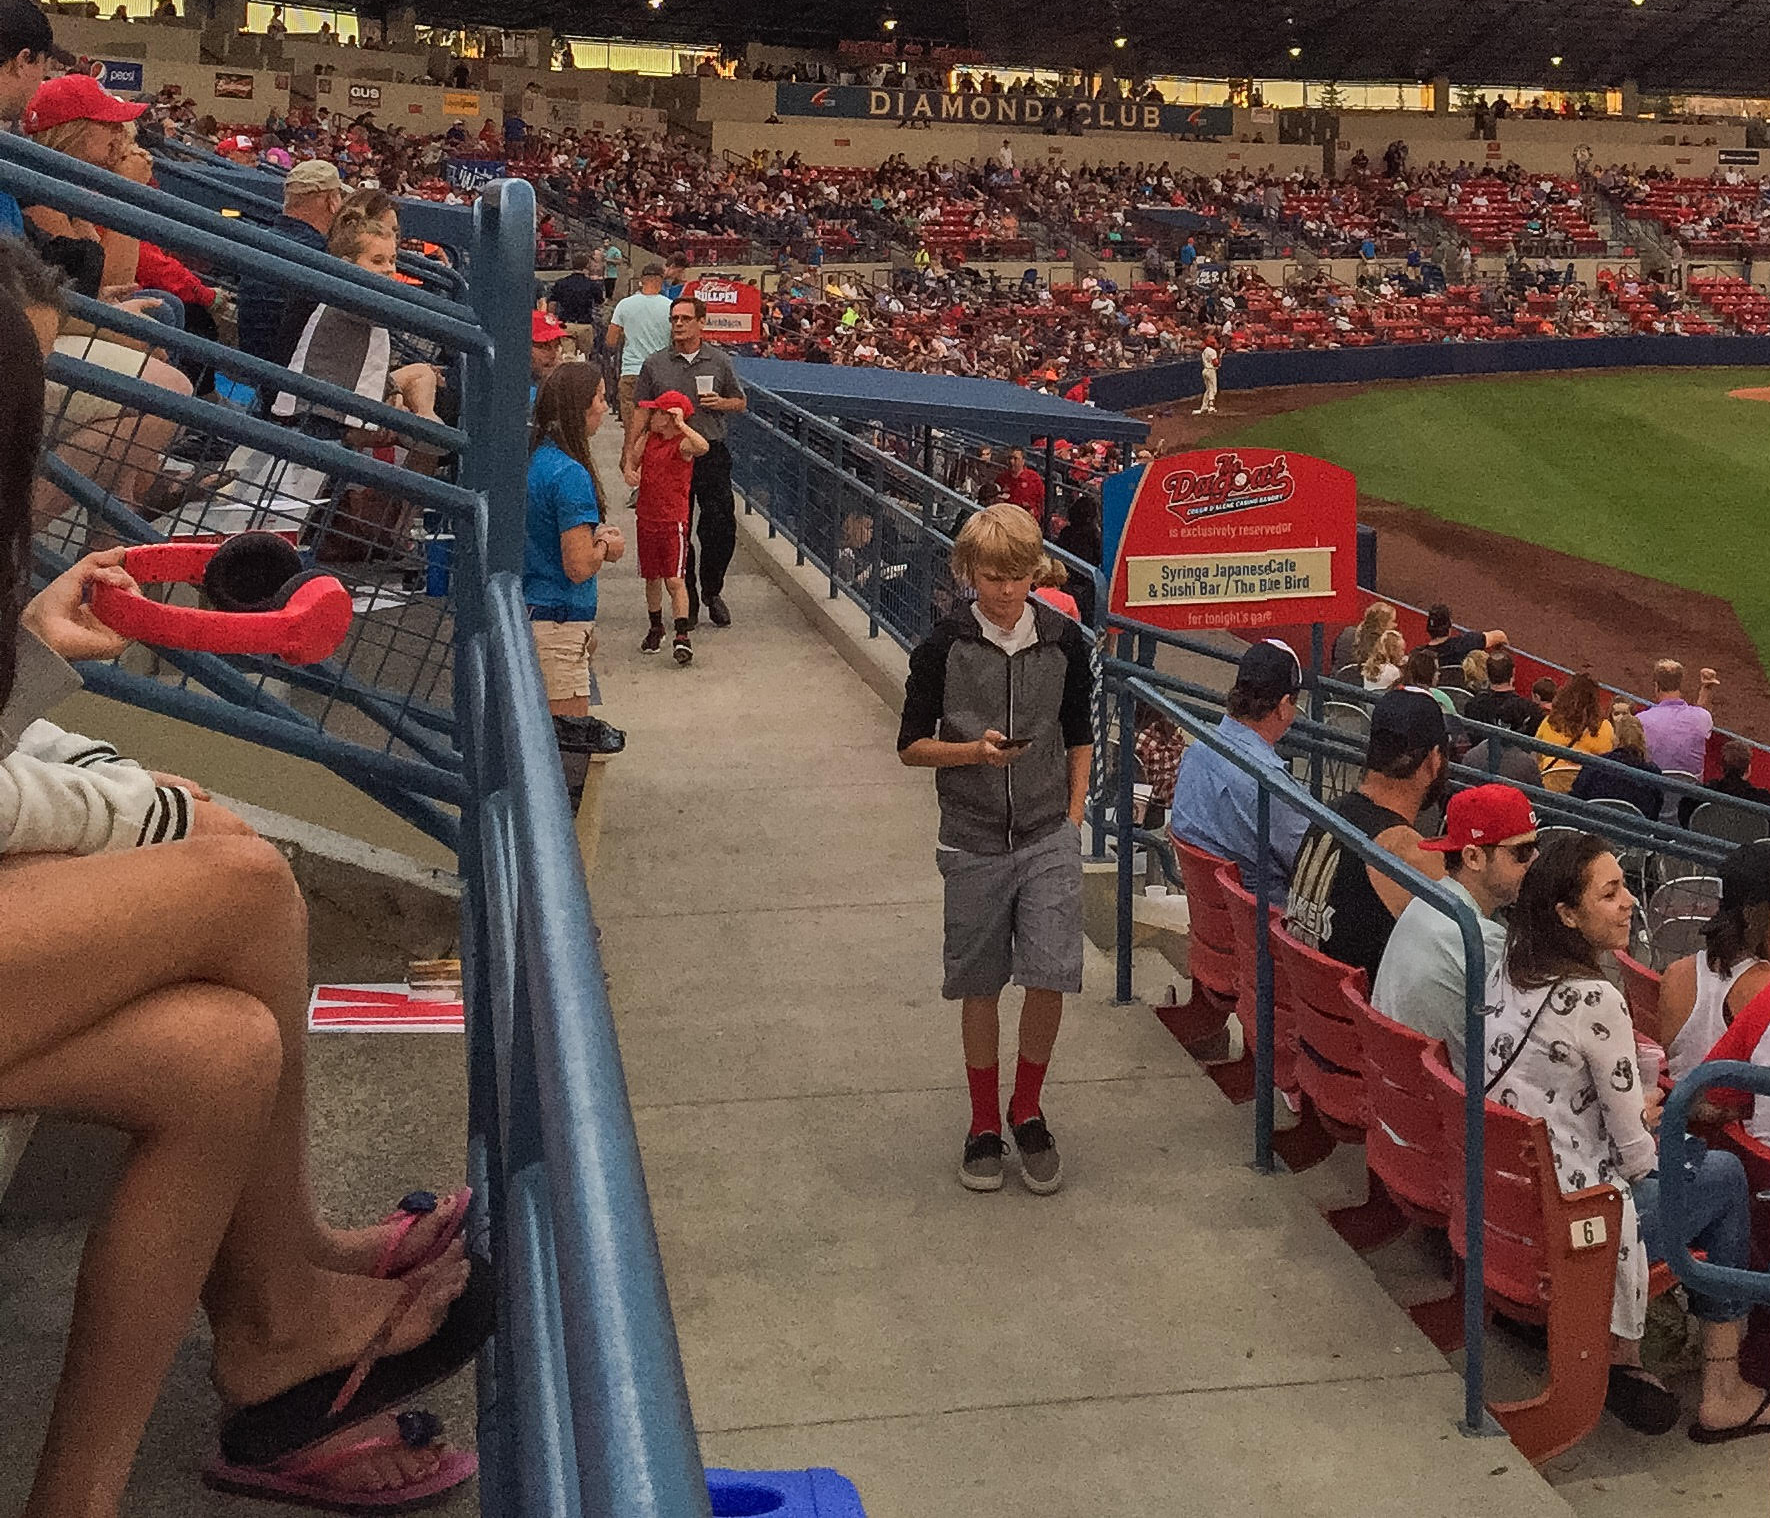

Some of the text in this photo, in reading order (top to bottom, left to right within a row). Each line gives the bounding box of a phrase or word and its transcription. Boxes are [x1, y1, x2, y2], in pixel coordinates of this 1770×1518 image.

[110, 68, 136, 83] pepsi
[350, 86, 380, 100] GUS
[869, 90, 1042, 123] DIAMOND
[1163, 455, 1289, 504] Dugout
[1168, 523, 1237, 539] is exclusively
[1161, 565, 1209, 583] Syringa
[1148, 575, 1310, 598] & Sushi Bar The Bird
[1188, 611, 1249, 626] for tonight's
[1582, 1220, 1594, 1245] 6
